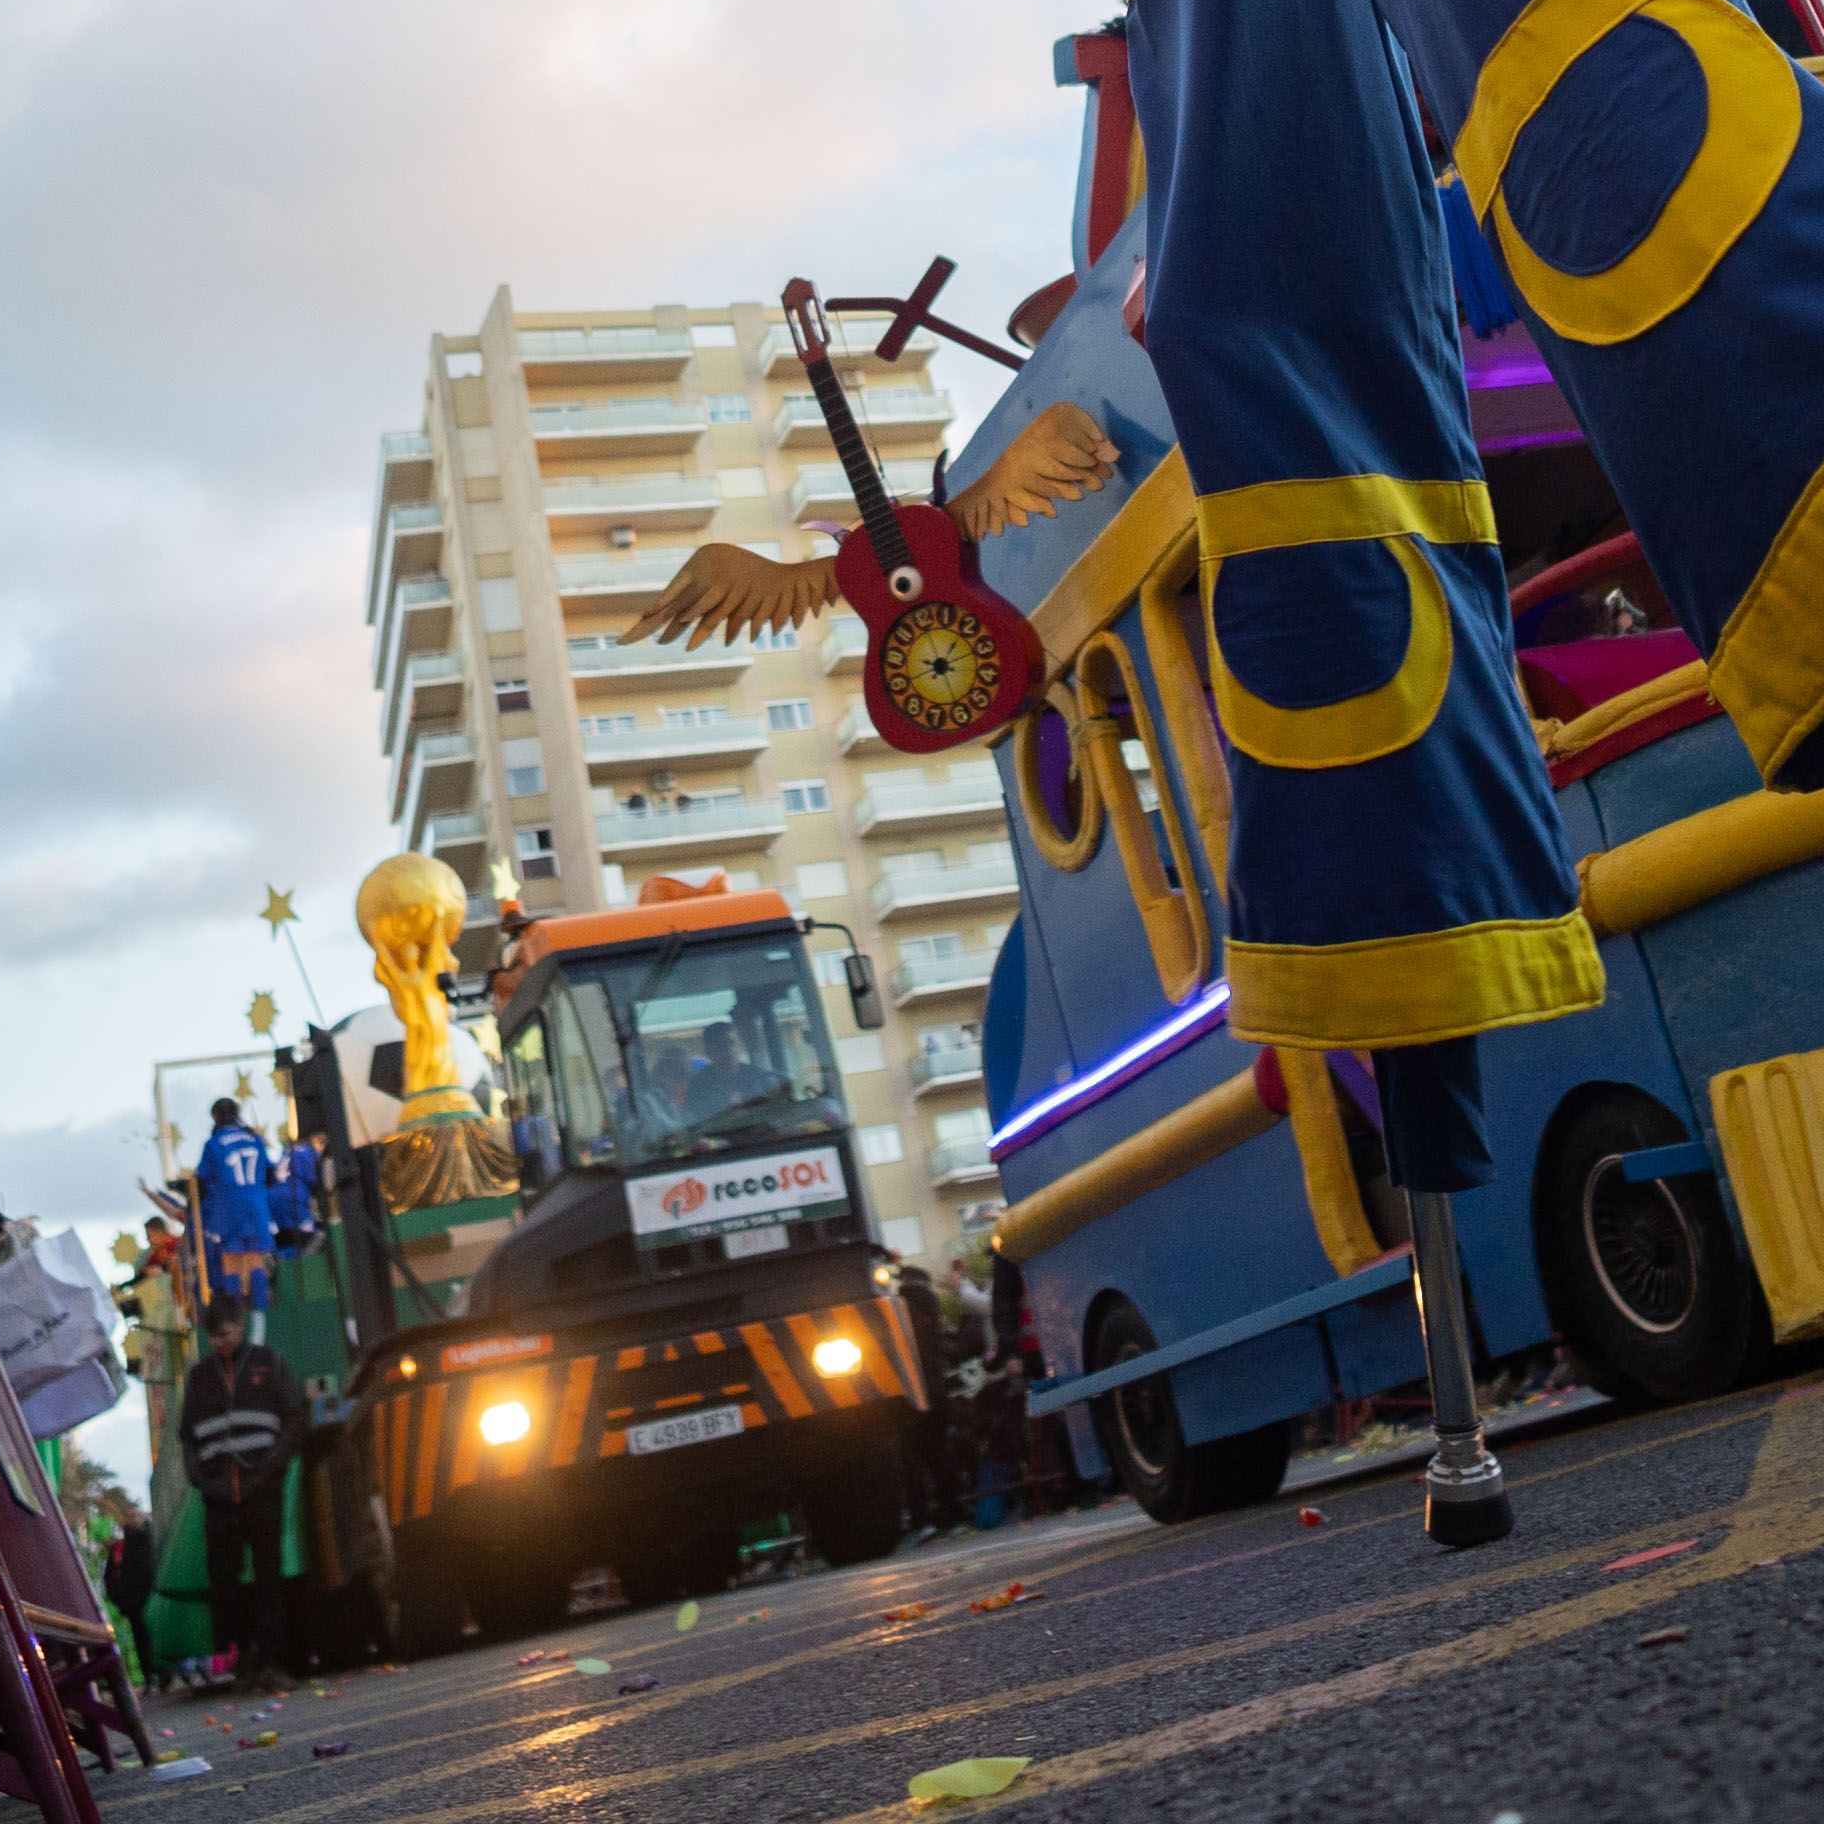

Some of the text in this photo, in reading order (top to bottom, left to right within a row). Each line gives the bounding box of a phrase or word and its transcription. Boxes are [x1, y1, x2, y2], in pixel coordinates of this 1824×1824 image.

[943, 606, 950, 626] 1
[963, 616, 976, 635] 2
[976, 640, 995, 656] 3
[890, 676, 907, 692] 9
[979, 667, 998, 683] 4
[907, 696, 920, 716] 8
[970, 689, 989, 707] 5
[930, 707, 941, 726] 7
[953, 705, 969, 725] 6
[224, 1147, 259, 1186] 17
